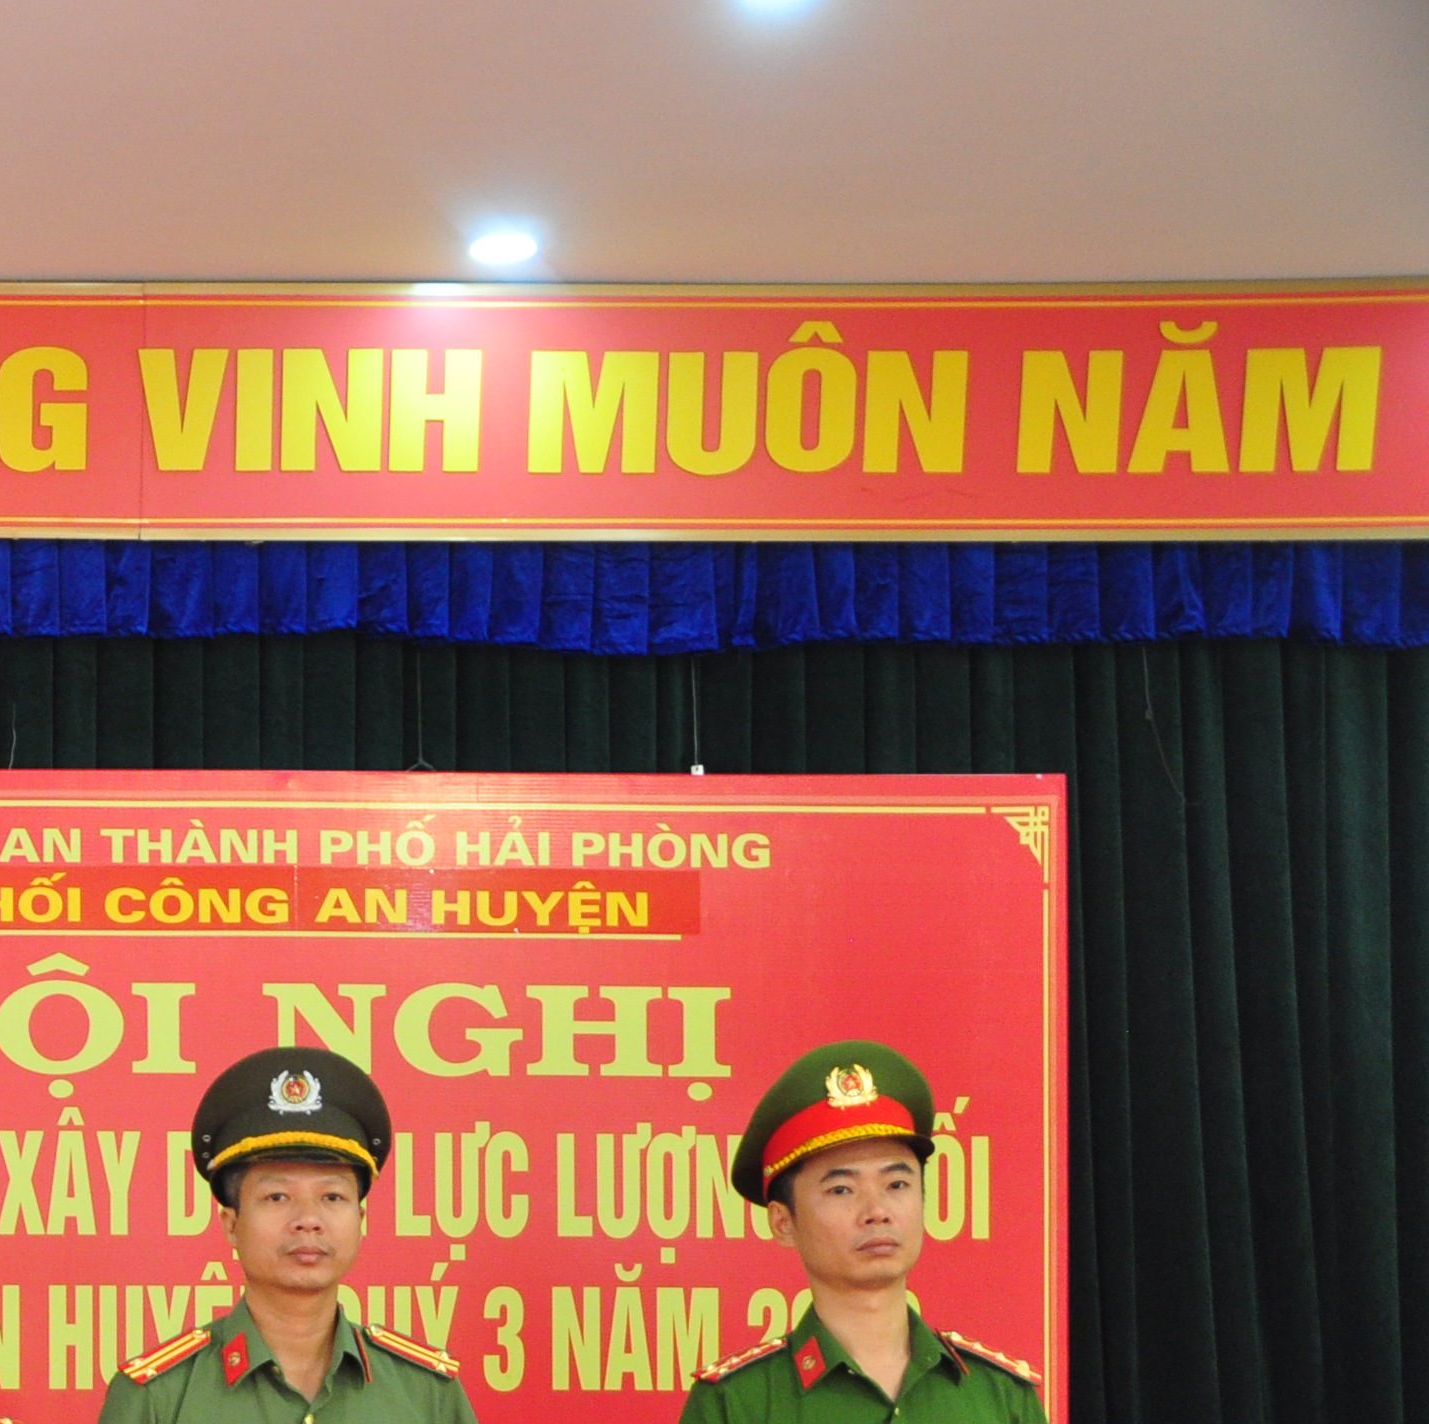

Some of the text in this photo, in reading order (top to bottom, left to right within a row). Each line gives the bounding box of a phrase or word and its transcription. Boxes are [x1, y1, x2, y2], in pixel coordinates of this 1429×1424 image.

[138, 349, 482, 474] VINH
[526, 322, 966, 477] MUÔN
[1016, 320, 1381, 475] NĂM
[100, 817, 298, 864] THÀNH
[320, 813, 435, 867] PHỐ
[456, 814, 552, 866] HẢI
[572, 820, 771, 870] PHÒNG
[104, 877, 290, 925] CÔNG
[314, 888, 409, 925] AN
[432, 878, 650, 934] HUYỆN
[262, 982, 732, 1101] NGHỊ
[395, 1120, 530, 1260] LỰC
[48, 1261, 245, 1391] HUY
[483, 1286, 525, 1392] 3
[551, 1263, 720, 1392] NĂM
